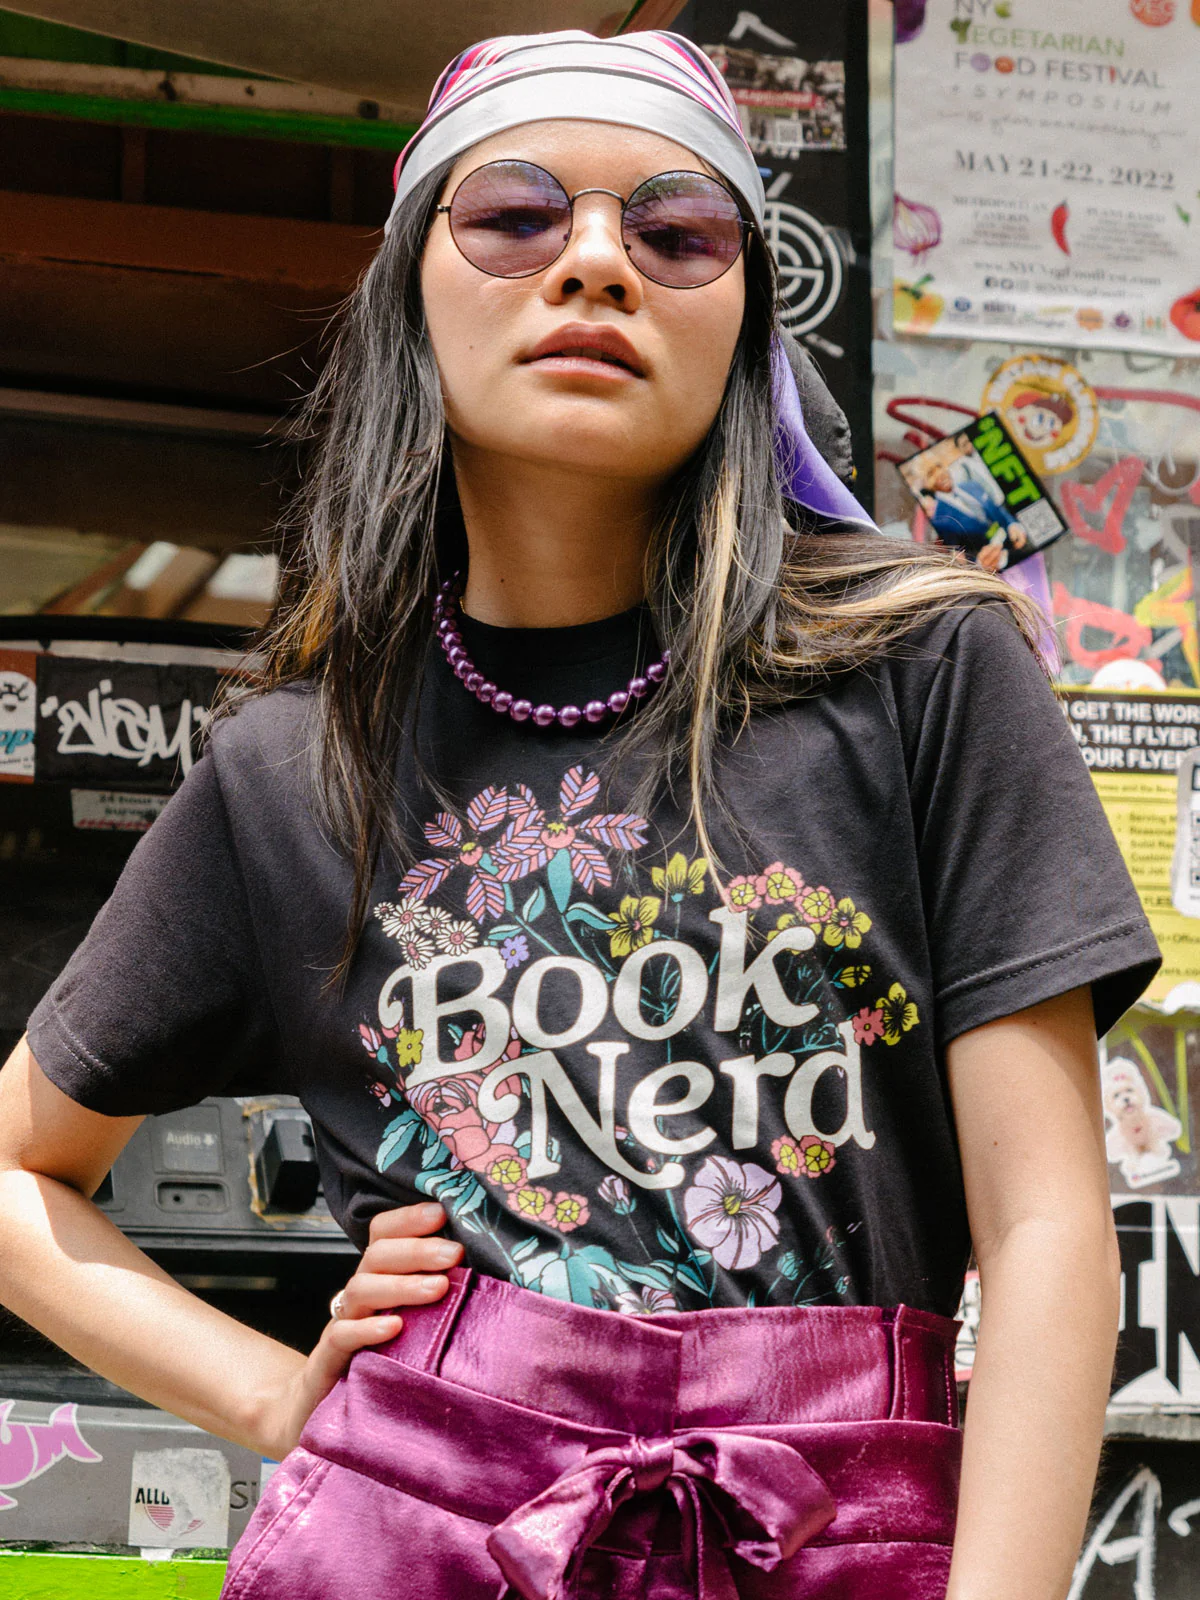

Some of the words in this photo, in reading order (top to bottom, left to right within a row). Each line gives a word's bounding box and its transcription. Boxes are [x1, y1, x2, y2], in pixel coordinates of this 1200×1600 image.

[950, 17, 1125, 57] VEGETARIAN
[954, 51, 1036, 77] FOOD
[1045, 59, 1166, 89] FESTIVAL
[955, 150, 1010, 179] MAY
[1020, 156, 1104, 185] 21-22,
[1109, 166, 1176, 191] 2022
[1069, 700, 1111, 720] GET
[1112, 702, 1152, 722] THE
[1089, 724, 1131, 745] THE
[1133, 725, 1198, 747] FLYER
[1079, 746, 1125, 768] OUR
[378, 906, 820, 1090] Book
[477, 1020, 876, 1189] Nerd
[166, 1131, 201, 1146] Audio
